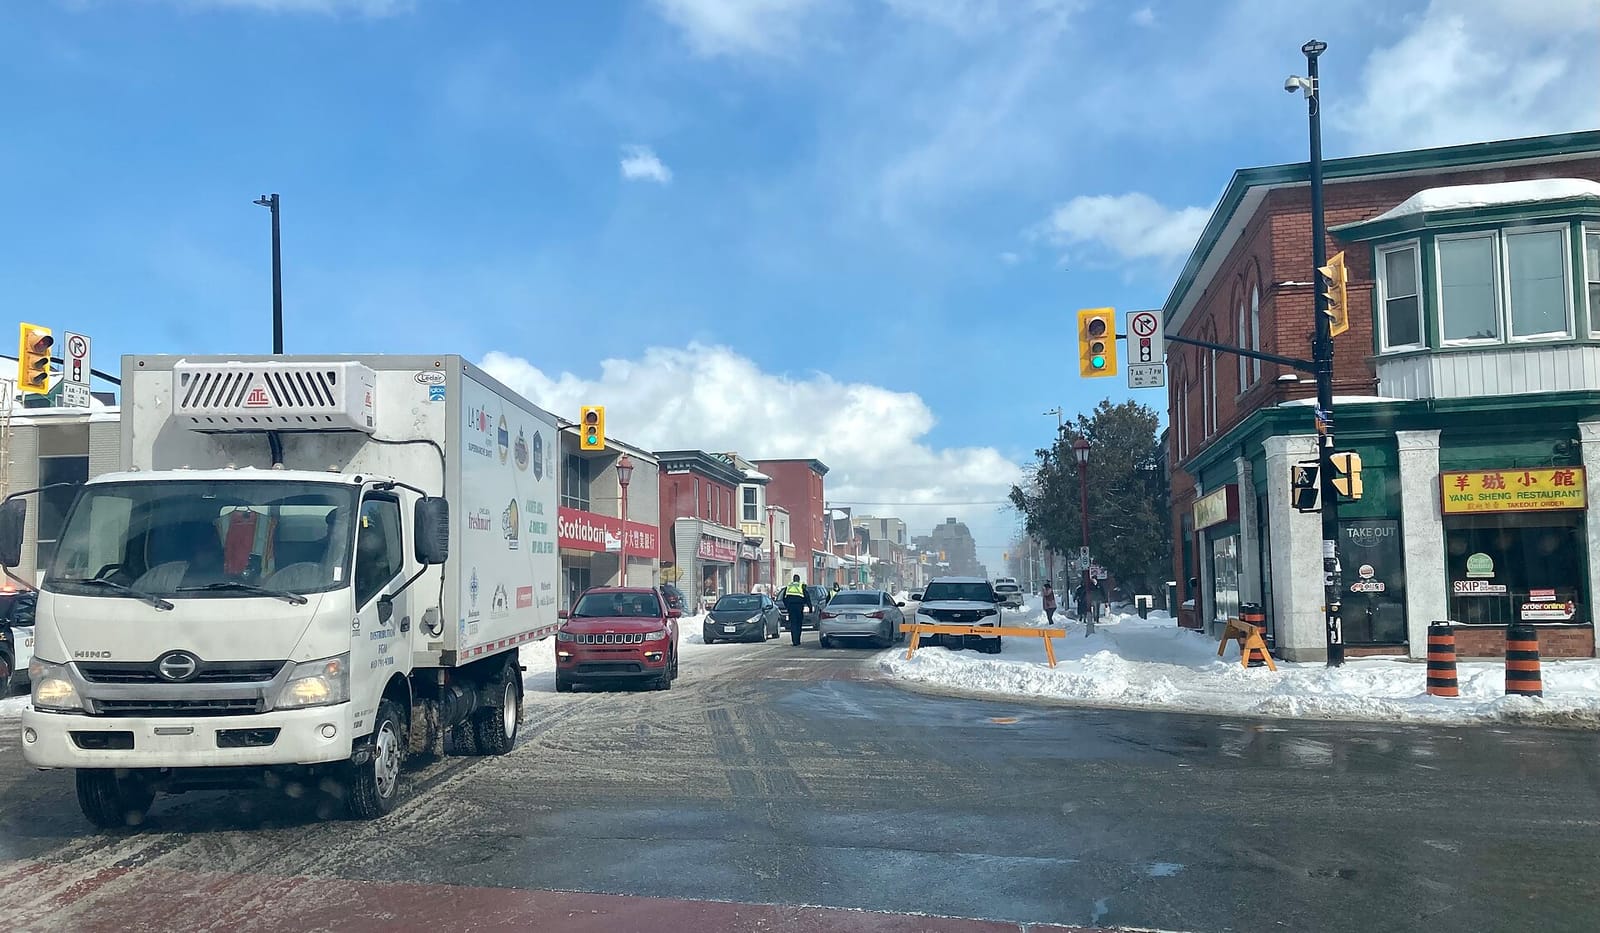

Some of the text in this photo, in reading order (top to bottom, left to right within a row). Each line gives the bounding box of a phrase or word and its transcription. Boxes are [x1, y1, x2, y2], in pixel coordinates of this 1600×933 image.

[1149, 367, 1153, 375] 7
[1454, 470, 1576, 491] 羊城小館
[1449, 489, 1581, 502] YANG SHENG RESTAURANT
[1507, 501, 1538, 509] TAKEOUT
[1540, 500, 1565, 508] ORDER
[1455, 581, 1479, 592] SKIP
[74, 650, 112, 659] HINO
